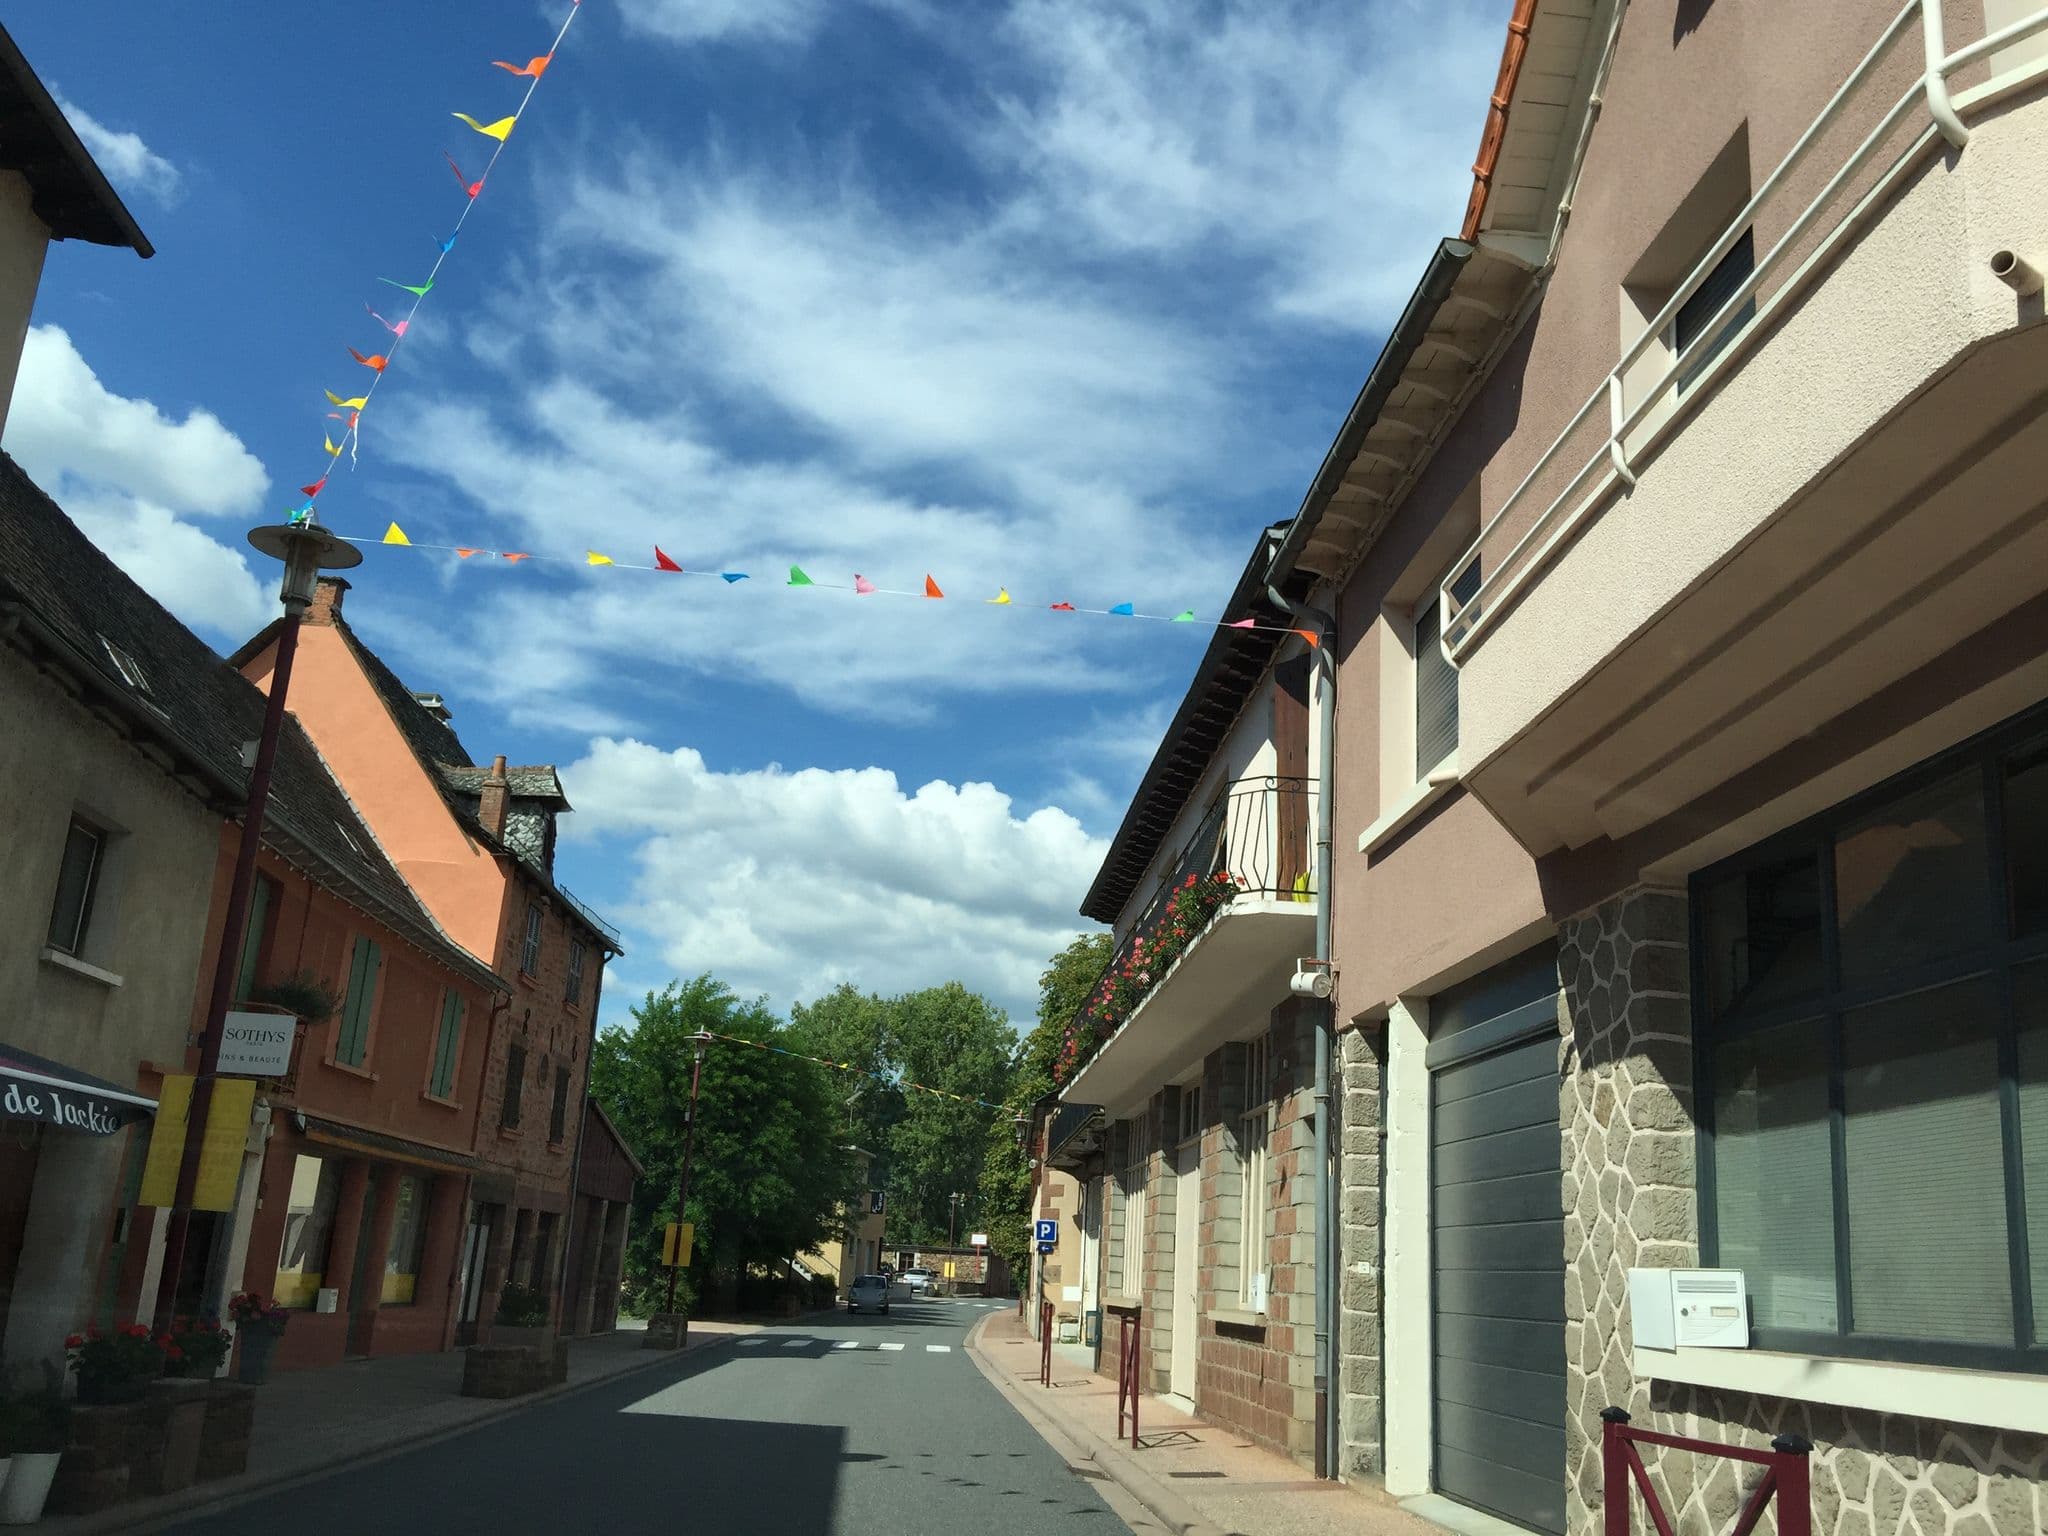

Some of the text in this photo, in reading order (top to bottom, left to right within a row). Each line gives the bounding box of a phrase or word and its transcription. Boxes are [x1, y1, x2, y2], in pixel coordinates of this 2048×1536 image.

[225, 1028, 286, 1043] SOTHYS
[221, 1053, 236, 1061] INS
[4, 1084, 118, 1133] de Jackie
[1041, 1223, 1051, 1238] P
